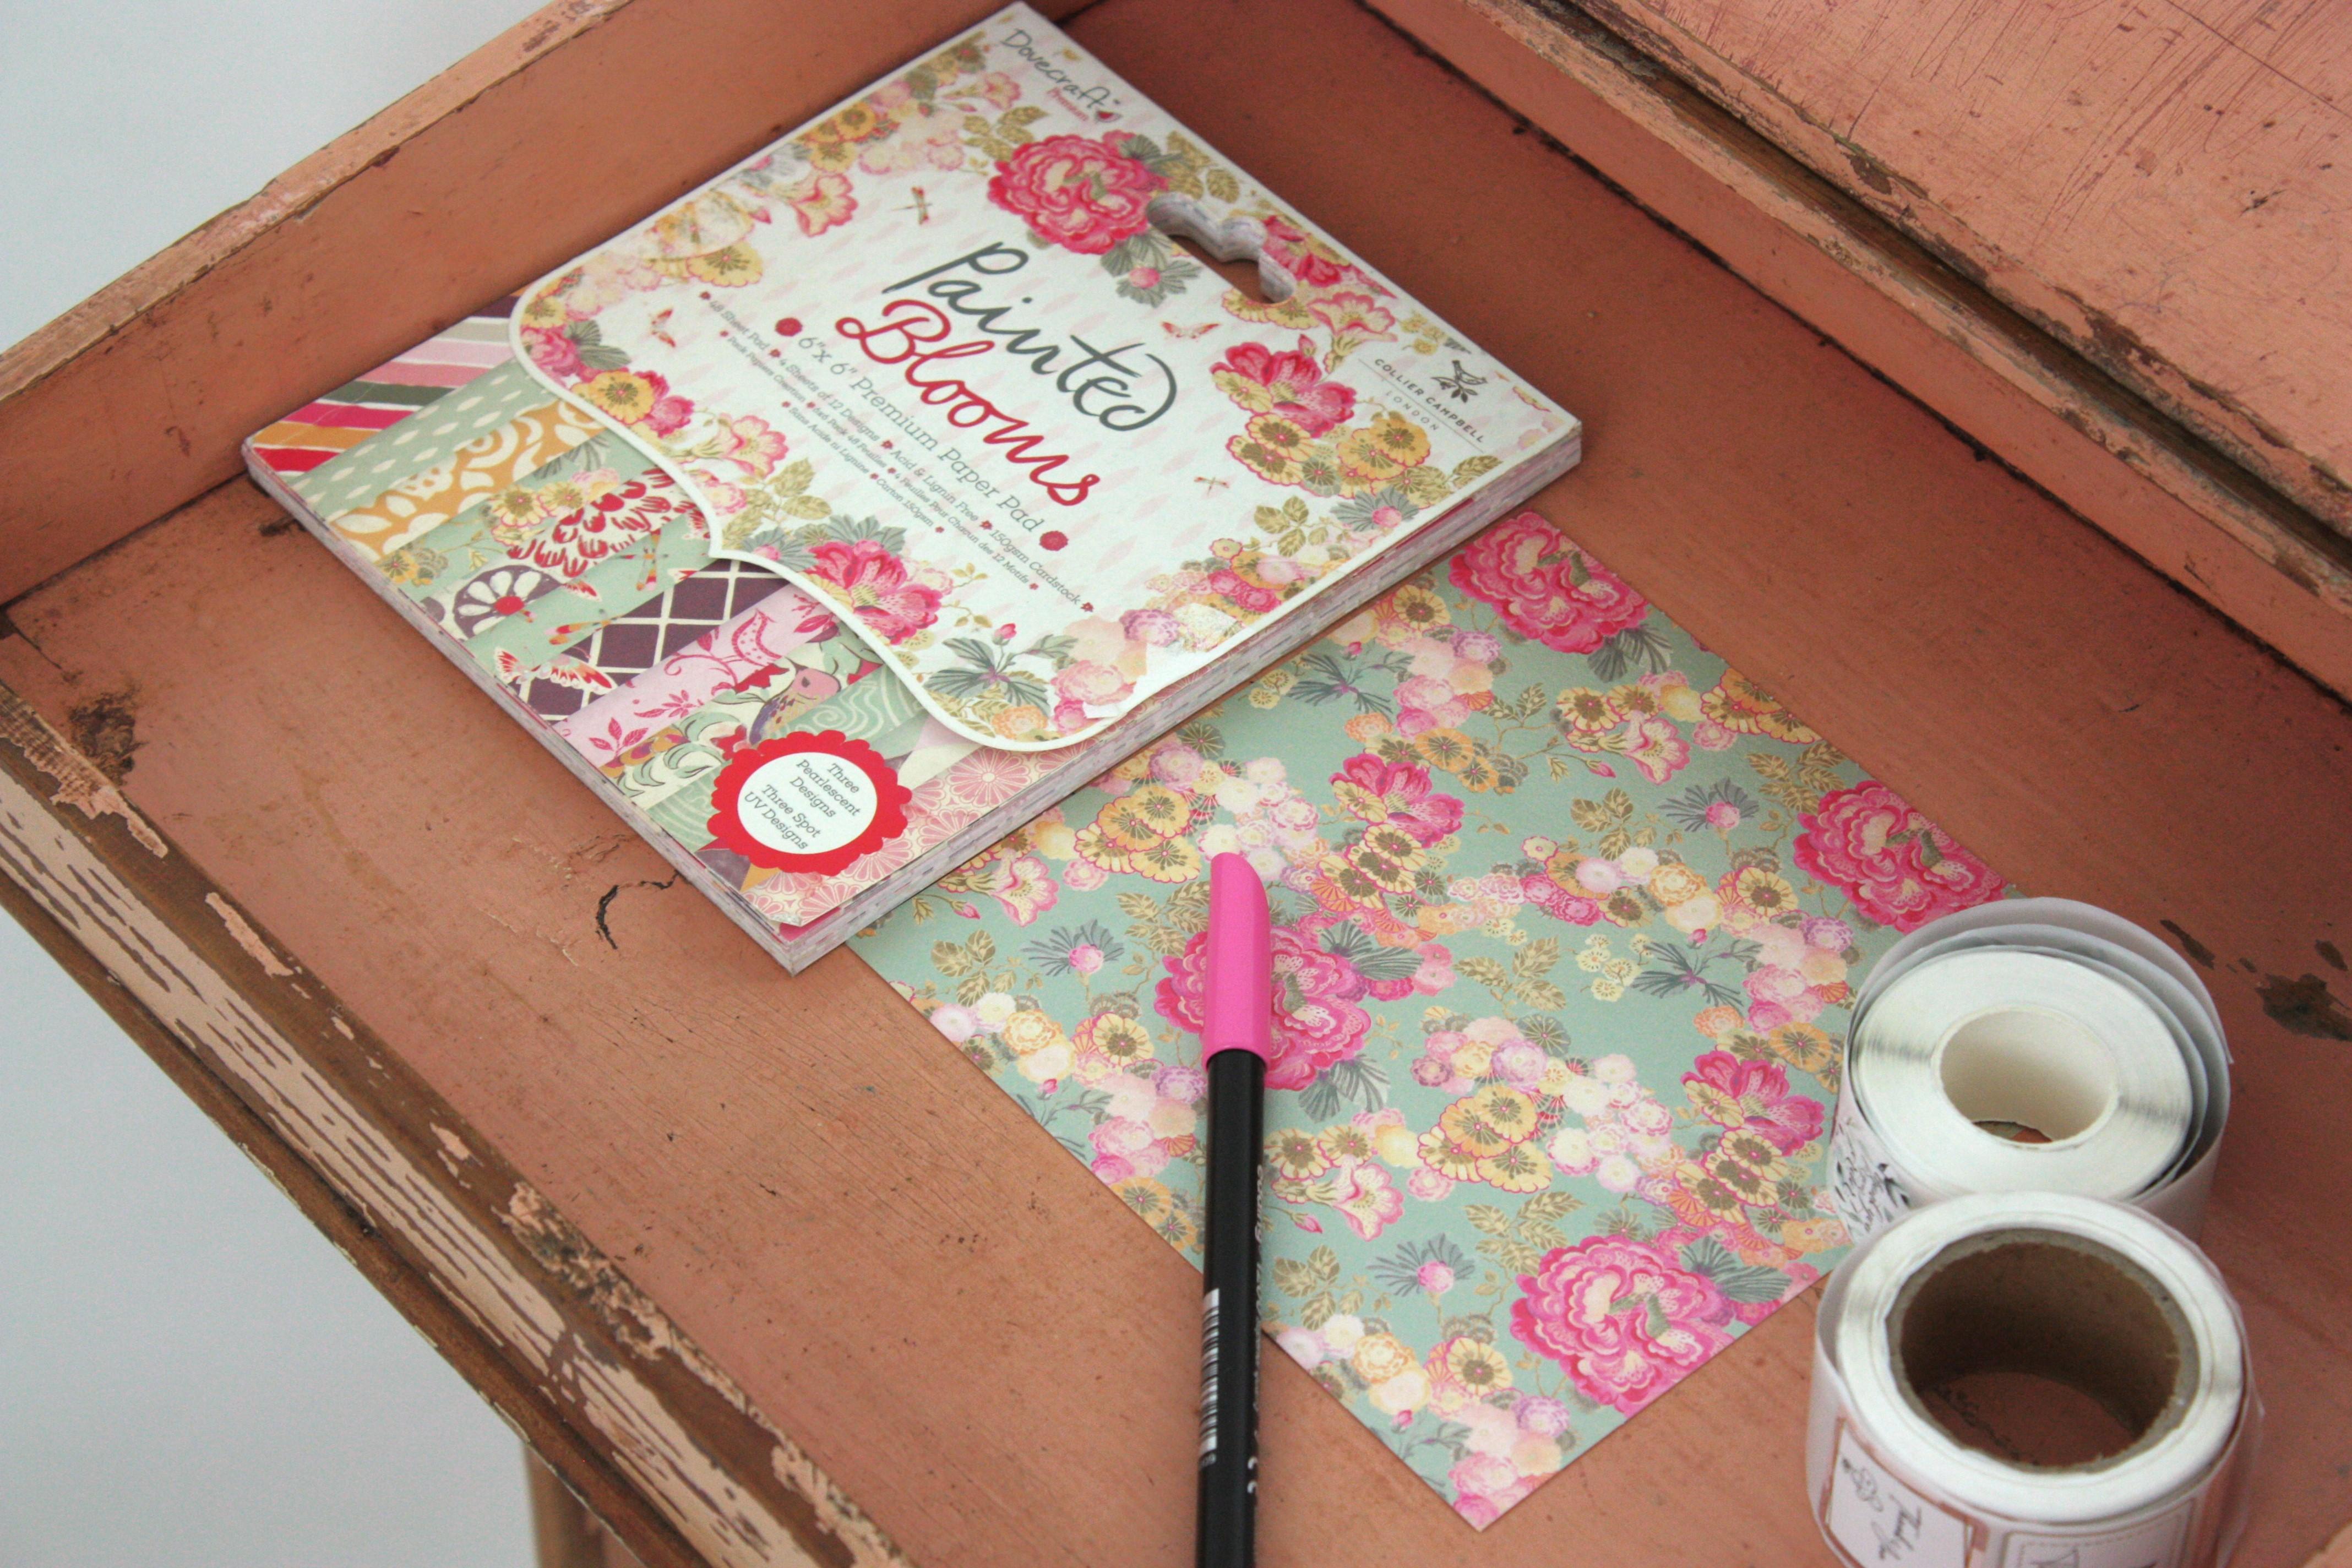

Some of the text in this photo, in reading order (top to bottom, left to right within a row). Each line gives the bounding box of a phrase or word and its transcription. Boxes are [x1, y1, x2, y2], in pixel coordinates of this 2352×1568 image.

[1000, 29, 1110, 109] Dovecraft
[882, 242, 1177, 431] Painted
[835, 299, 1101, 507] Blooms
[1375, 358, 1487, 443] COLLIER CAMPBELL
[1386, 390, 1440, 431] LONDON
[710, 301, 724, 312] 48
[721, 311, 750, 334] Sheet
[748, 333, 770, 351] Pad
[786, 364, 819, 392] Sheets
[817, 391, 834, 401] of
[827, 399, 844, 410] 12
[840, 408, 881, 441] Designs
[890, 450, 917, 471] Acid
[914, 468, 925, 477] &
[922, 475, 956, 504] Lignin
[954, 502, 979, 521] Free
[989, 529, 1030, 564] 150gsm
[1029, 561, 1082, 605] Cardstock
[727, 336, 748, 353] Pack
[827, 418, 848, 435] Pack
[857, 443, 888, 467] Feuilles
[900, 477, 930, 503] Feuilles
[929, 501, 949, 519] Pour
[948, 516, 979, 543] Chacun
[978, 542, 994, 555] des
[992, 553, 1005, 563] 12
[1003, 560, 1030, 584] Motifs
[808, 424, 831, 443] Acide
[839, 448, 869, 474] Lignine
[876, 478, 903, 502] Carton
[902, 500, 934, 527] 150gsm
[850, 376, 938, 451] Premium
[937, 447, 1000, 498] Paper
[996, 494, 1045, 532] Pad
[761, 784, 821, 839] Three Spot
[790, 776, 837, 818] Designs
[796, 759, 862, 816] Pearlescent
[826, 763, 860, 793] Three
[744, 791, 809, 850] UV Designs
